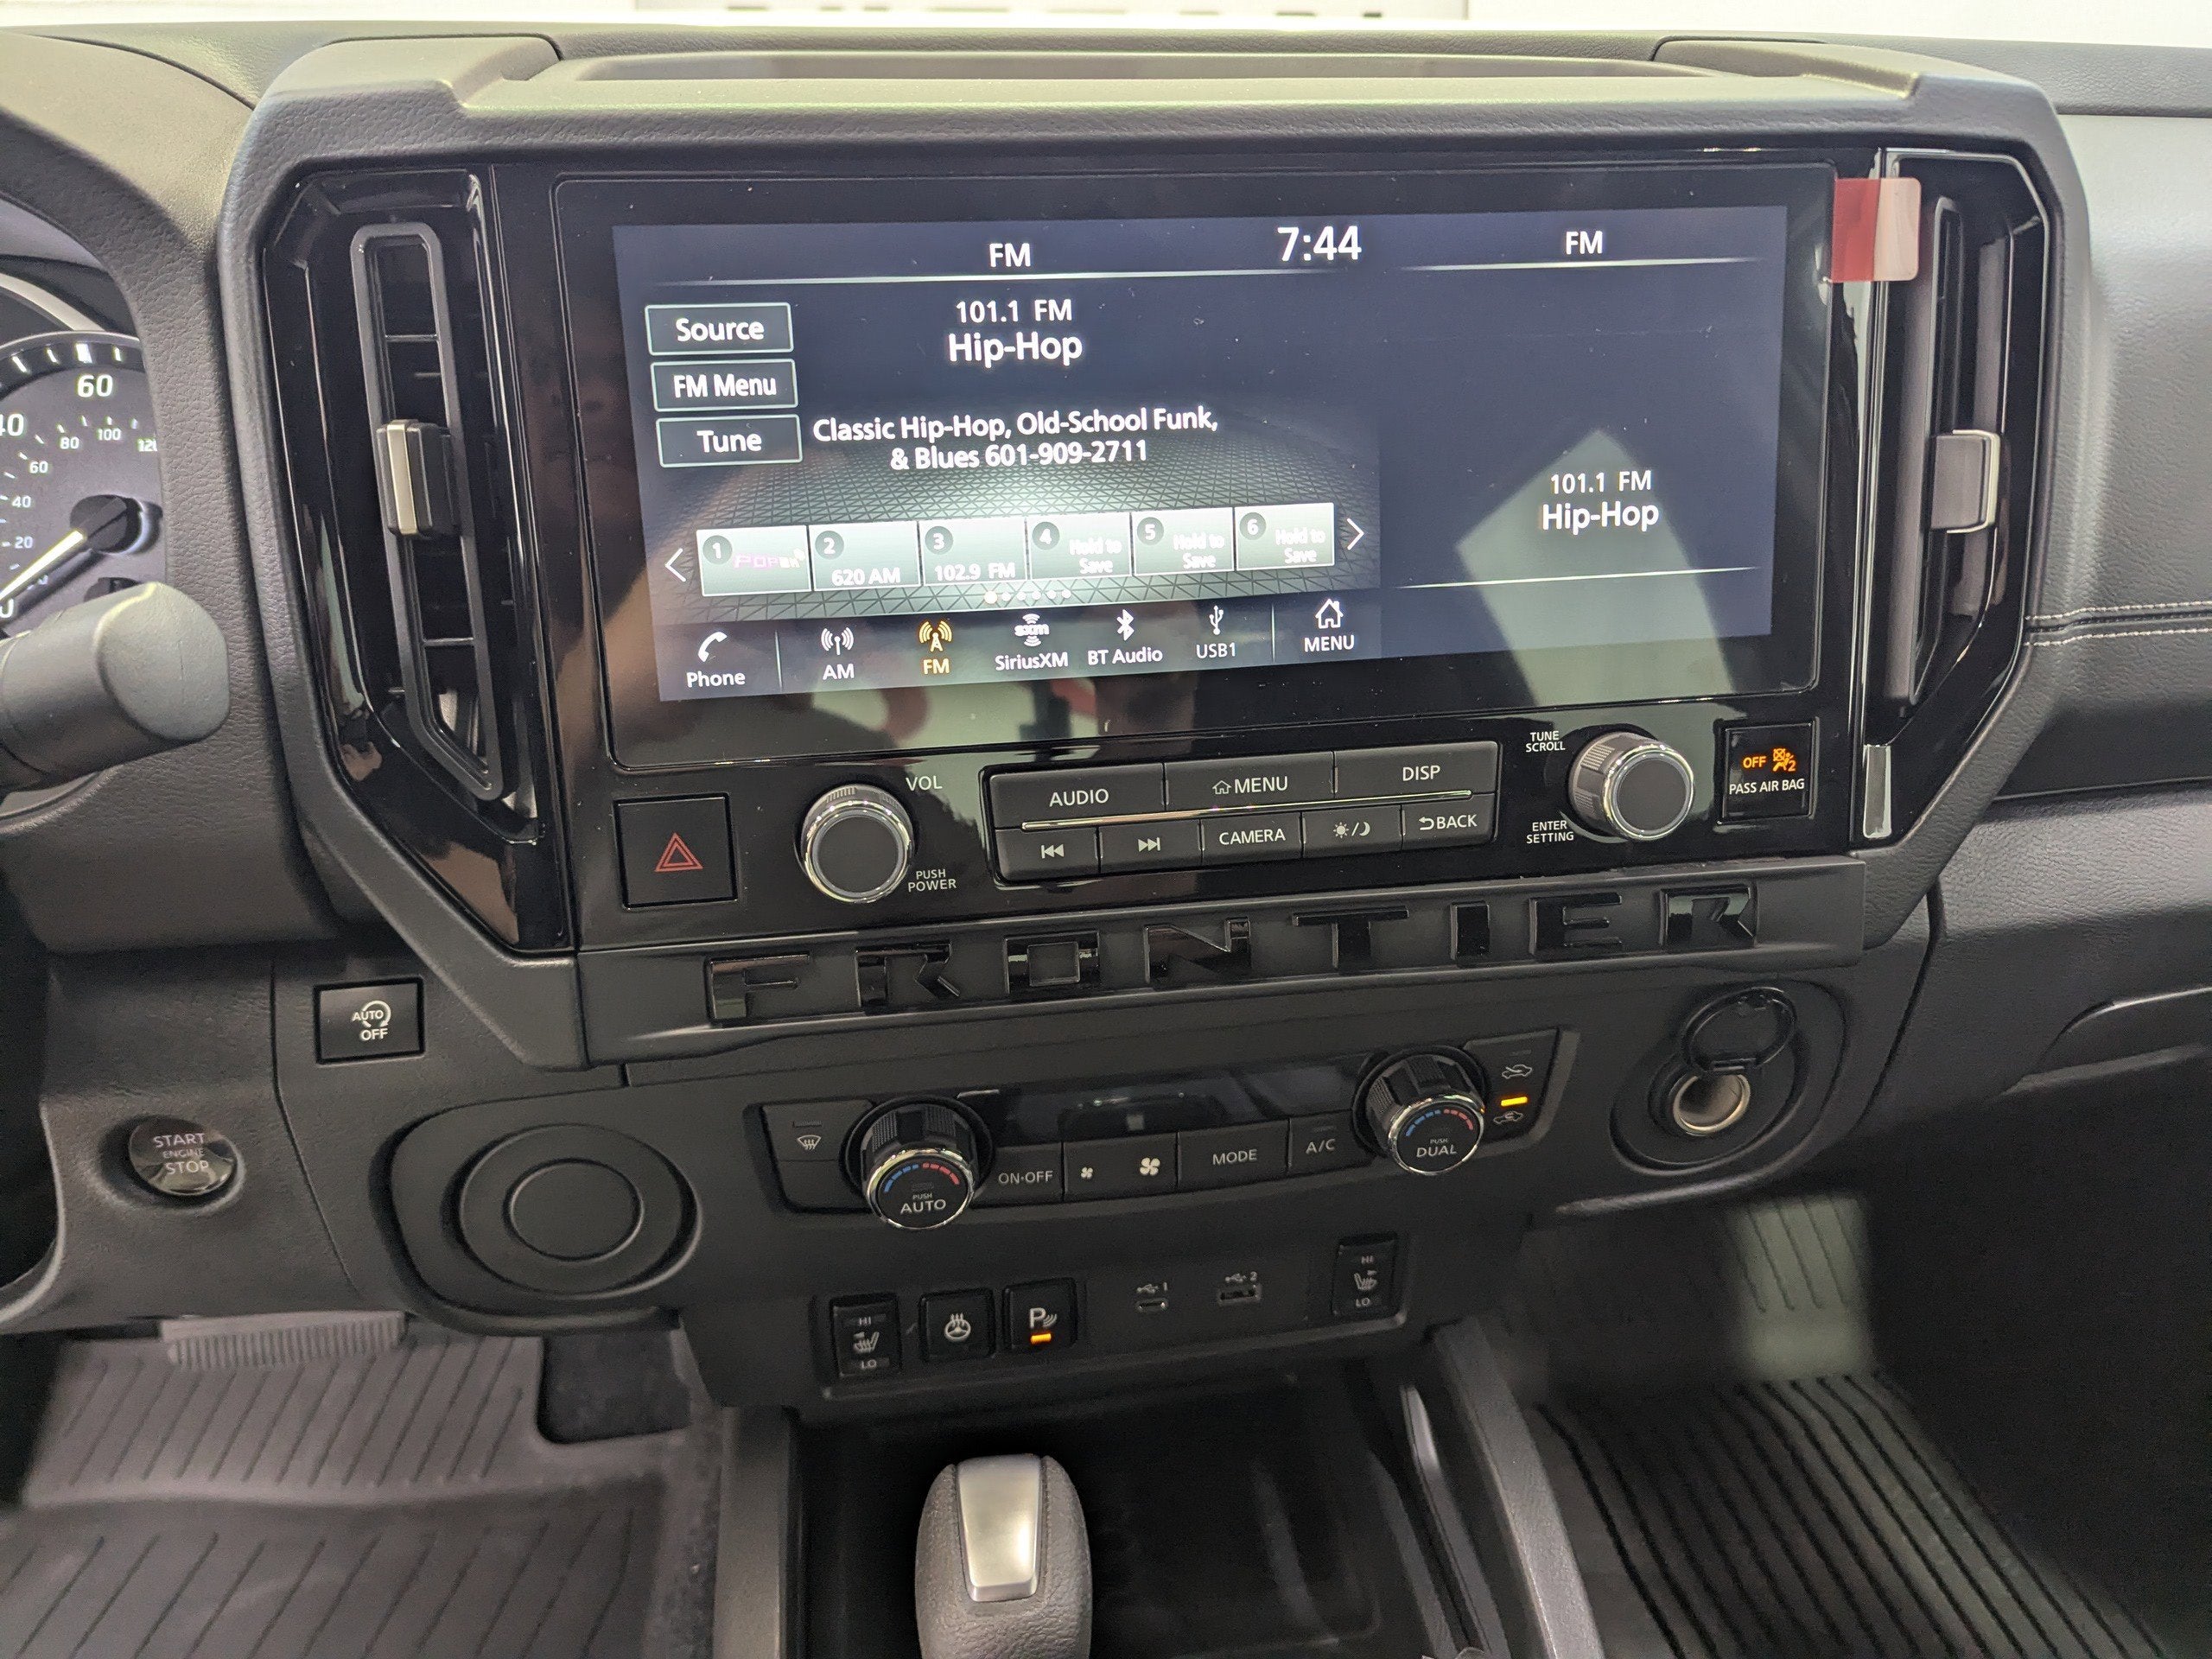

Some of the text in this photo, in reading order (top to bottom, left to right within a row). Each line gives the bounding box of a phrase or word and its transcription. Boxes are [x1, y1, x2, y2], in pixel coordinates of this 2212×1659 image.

[1277, 226, 1362, 262] 7:44
[1566, 231, 1603, 254] FM
[989, 243, 1031, 267] FM
[956, 299, 1073, 323] 101.1 FM
[676, 317, 765, 342] Source
[948, 332, 1084, 368] Hip-Hop
[77, 374, 113, 397] 60
[673, 372, 778, 398] FM Menu
[0, 414, 24, 436] 0
[812, 406, 1218, 443] Classic Hip-Hop, Old-School Funk,
[60, 437, 79, 449] 80
[98, 429, 121, 442] 100
[696, 429, 762, 454] Tune
[890, 440, 1147, 471] & Blues 601-909-2711
[29, 461, 48, 474] 60
[1550, 470, 1652, 494] 101.1 FM
[12, 496, 31, 508] 40
[1542, 501, 1659, 535] Hip-Hop
[1144, 524, 1157, 542] 5
[1246, 518, 1258, 536] 6
[15, 536, 33, 549] 20
[932, 532, 945, 550] 3
[1039, 527, 1052, 545] 4
[1173, 534, 1225, 550] Hold to
[1275, 528, 1326, 545] Hold to
[711, 542, 722, 560] 1
[823, 537, 836, 555] 2
[1069, 538, 1122, 555] Hold to
[1182, 553, 1217, 569] Save
[1284, 547, 1318, 563] Save
[934, 562, 1016, 582] 102.9 FM
[1078, 557, 1114, 575] Save
[831, 567, 901, 587] 620 AM
[1196, 642, 1236, 658] USB1
[1304, 634, 1355, 652] MENU
[995, 652, 1069, 671] SiriusXM
[1087, 646, 1163, 665] BT Audio
[823, 663, 855, 681] AM
[923, 658, 950, 676] FM
[686, 671, 746, 689] Phone
[1529, 730, 1560, 743] TUNE
[1525, 741, 1566, 753] SCROLL
[1742, 755, 1767, 769] OFF
[1402, 765, 1440, 782] DISP
[906, 775, 943, 791] VOL
[1235, 776, 1288, 794] MENU
[1729, 778, 1805, 795] PASS AIR BAG
[1049, 788, 1109, 808] AUDIO
[1436, 814, 1478, 830] BACK
[1532, 820, 1567, 832] ENTER
[1219, 828, 1287, 846] CAMERA
[1526, 831, 1574, 844] SETTING
[915, 869, 946, 880] PUSH
[908, 878, 957, 893] POWER
[707, 887, 1758, 1026] FRONTIER
[352, 1009, 385, 1022] AUTO
[359, 1027, 389, 1041] OFF
[154, 1132, 205, 1148] START
[1306, 1138, 1336, 1155] A/C
[1430, 1136, 1448, 1145] PUSH
[162, 1147, 205, 1160] ENGINE
[1212, 1148, 1257, 1166] MODE
[1415, 1143, 1458, 1158] DUAL
[165, 1159, 209, 1175] STOP
[912, 1191, 933, 1201] PUSH
[900, 1198, 947, 1215] AUTO
[1361, 1255, 1374, 1264] HI
[1356, 1297, 1370, 1308] LO
[859, 1316, 872, 1325] HI
[861, 1358, 877, 1370] LO
